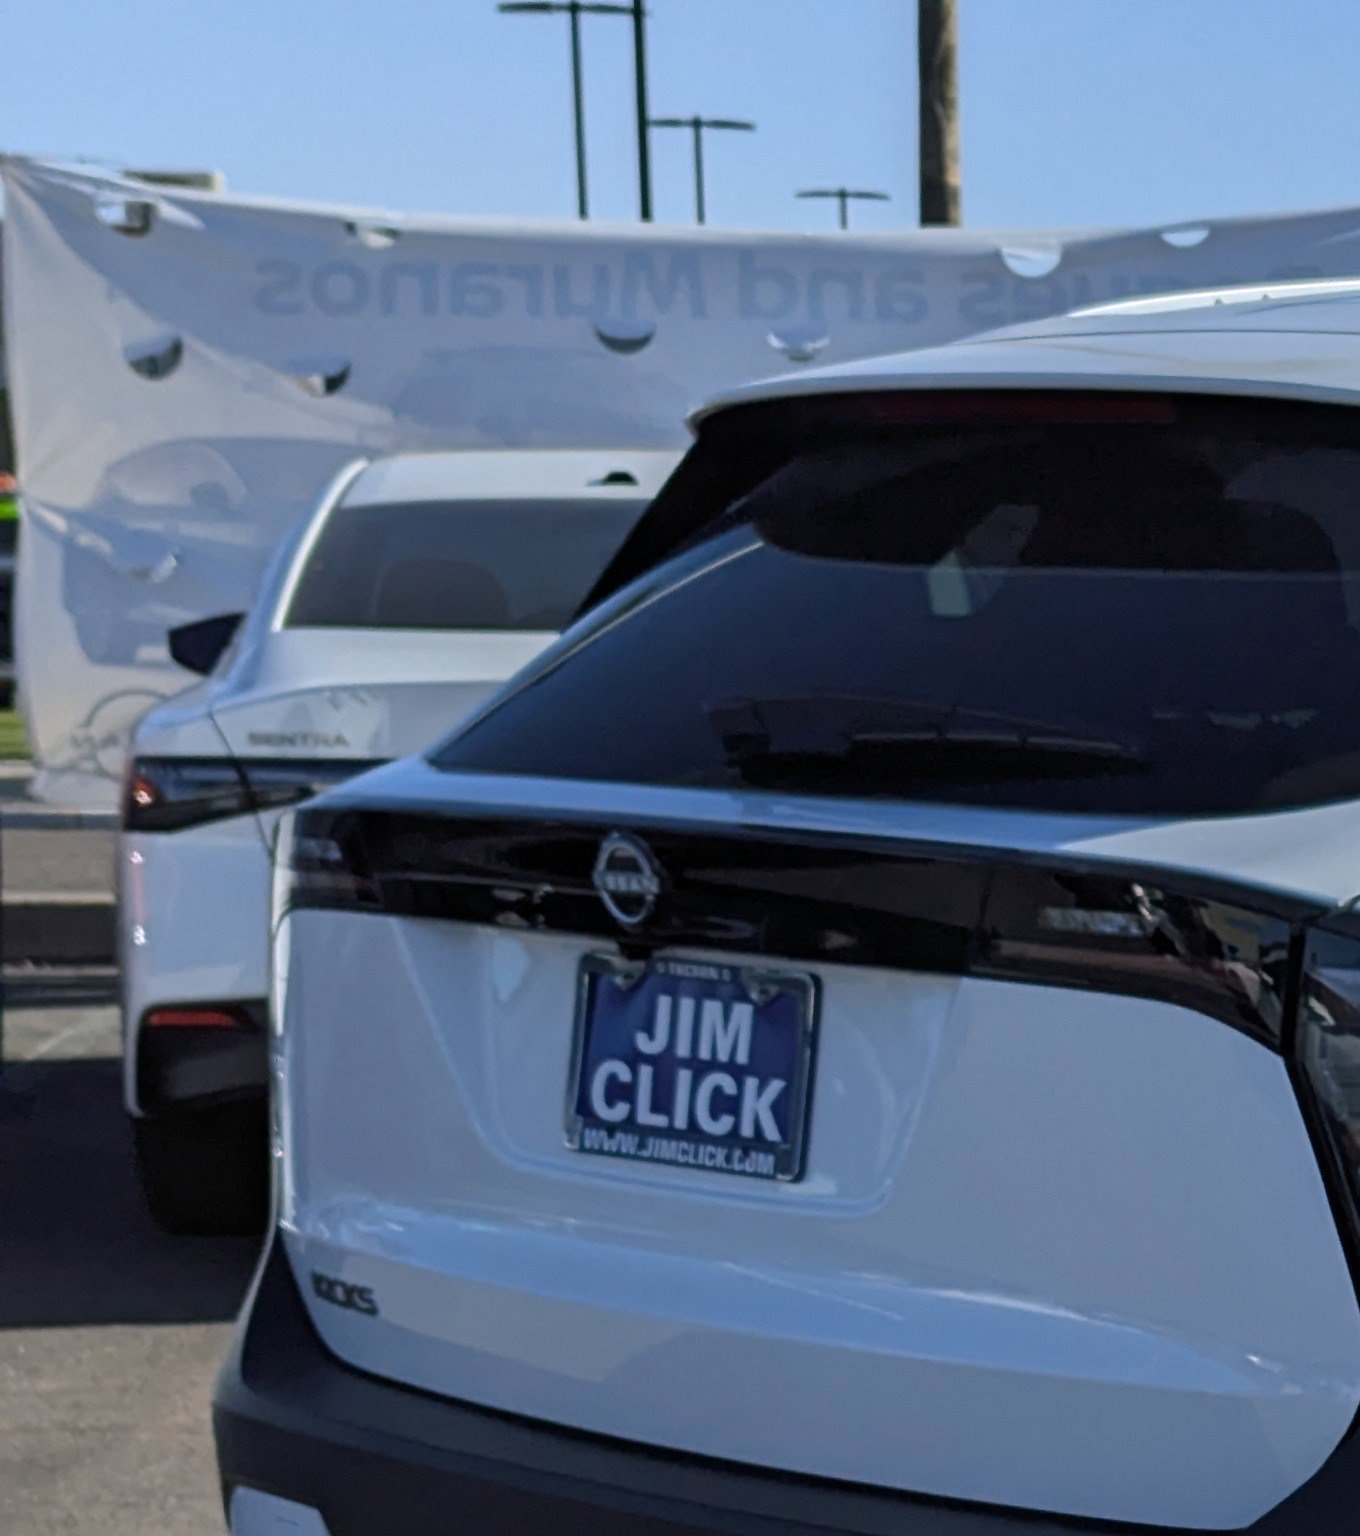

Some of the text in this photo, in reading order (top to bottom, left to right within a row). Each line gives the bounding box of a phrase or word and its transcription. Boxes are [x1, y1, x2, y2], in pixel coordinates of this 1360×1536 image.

[635, 994, 755, 1066] JIM
[591, 1059, 788, 1144] CLICK
[583, 1126, 776, 1176] WWW.JIMCLICK.COM
